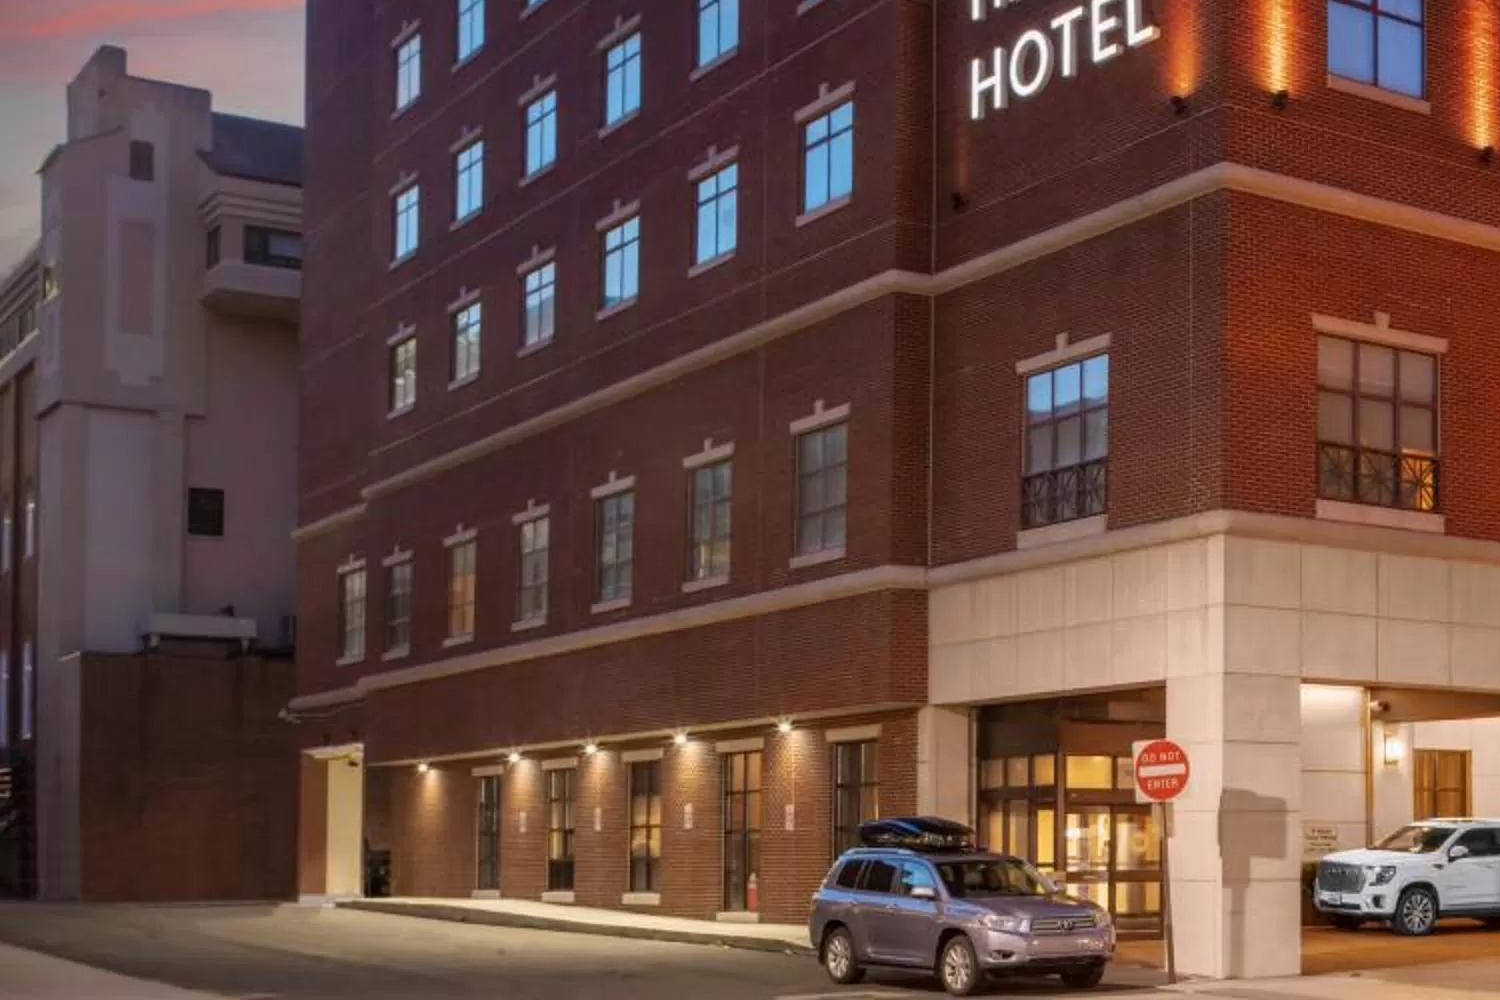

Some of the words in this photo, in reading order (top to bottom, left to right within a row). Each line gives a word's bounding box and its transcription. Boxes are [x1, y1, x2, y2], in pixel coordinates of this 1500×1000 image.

[1142, 752, 1157, 762] DO
[1159, 751, 1181, 761] NOT
[1147, 778, 1178, 790] ENTER
